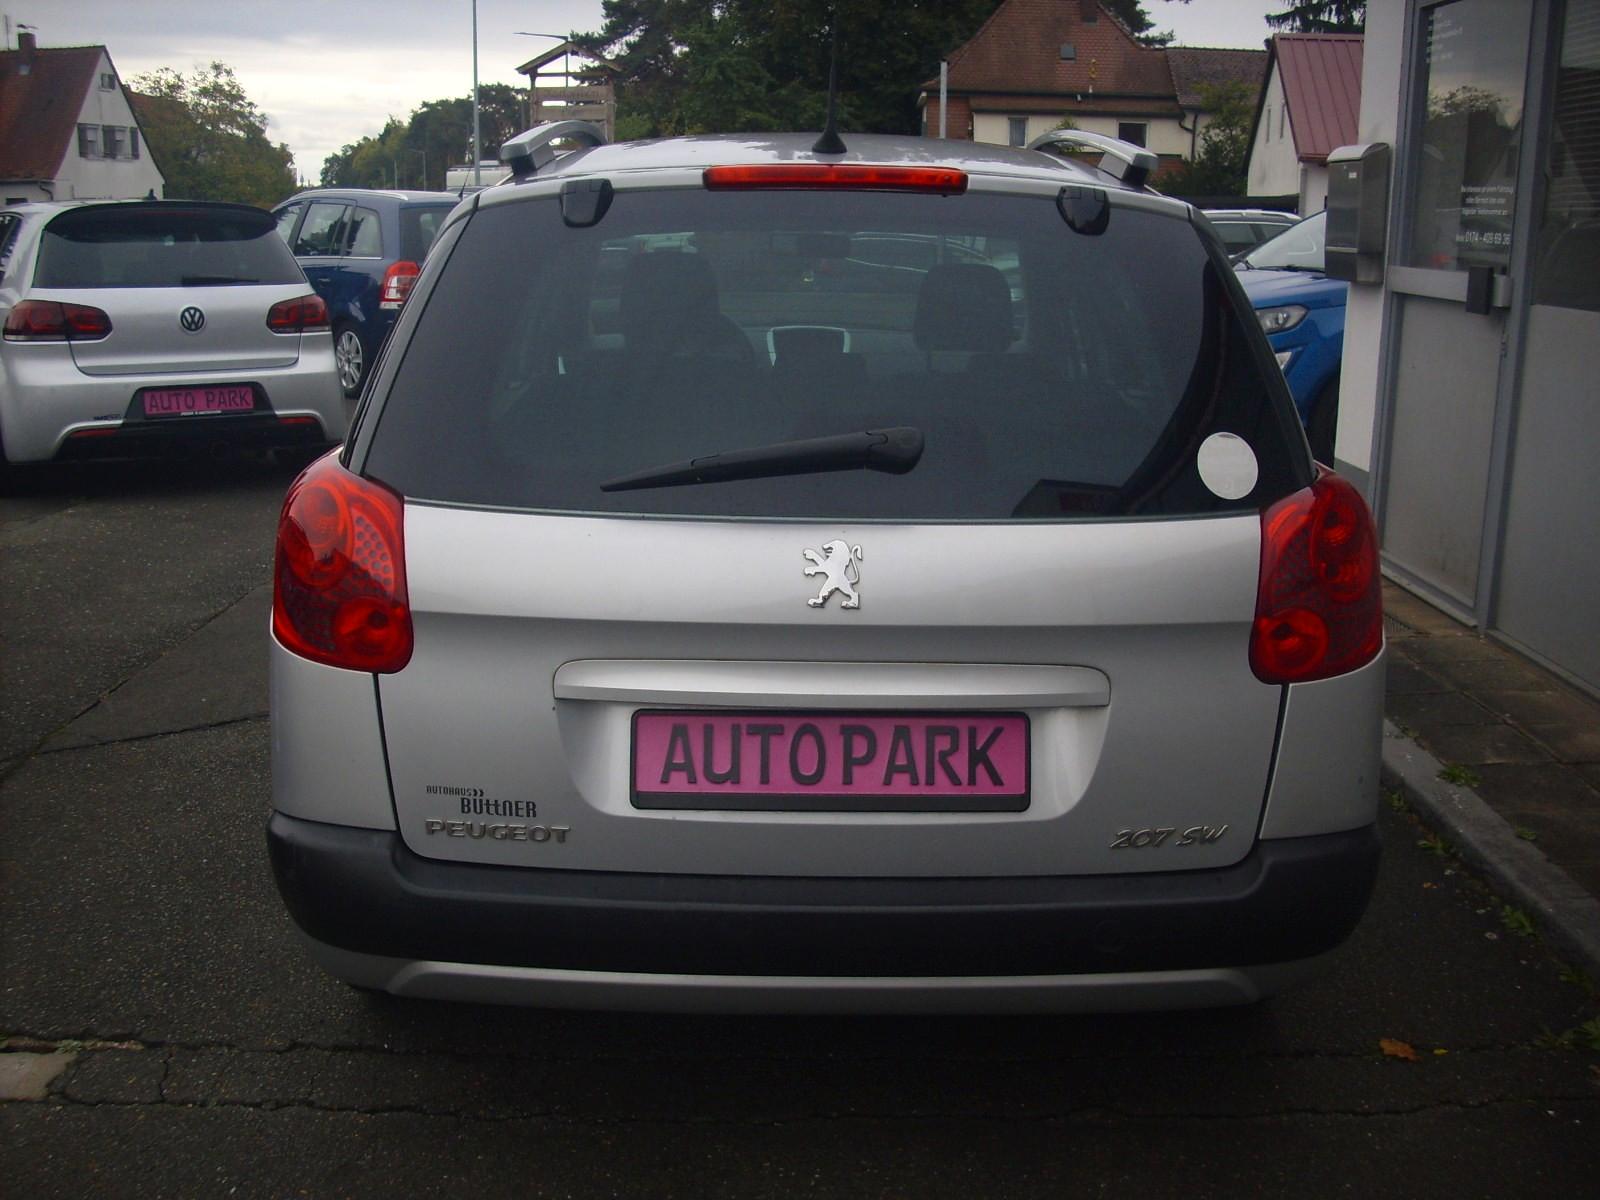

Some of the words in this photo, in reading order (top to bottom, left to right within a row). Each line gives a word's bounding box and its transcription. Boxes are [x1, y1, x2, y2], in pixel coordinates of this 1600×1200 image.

[147, 392, 196, 413] AUTO
[205, 389, 251, 408] PARK
[426, 785, 472, 797] AUTOHAUS
[425, 818, 571, 843] PEUGEOT
[1109, 828, 1176, 848] 207
[1175, 824, 1229, 846] SW
